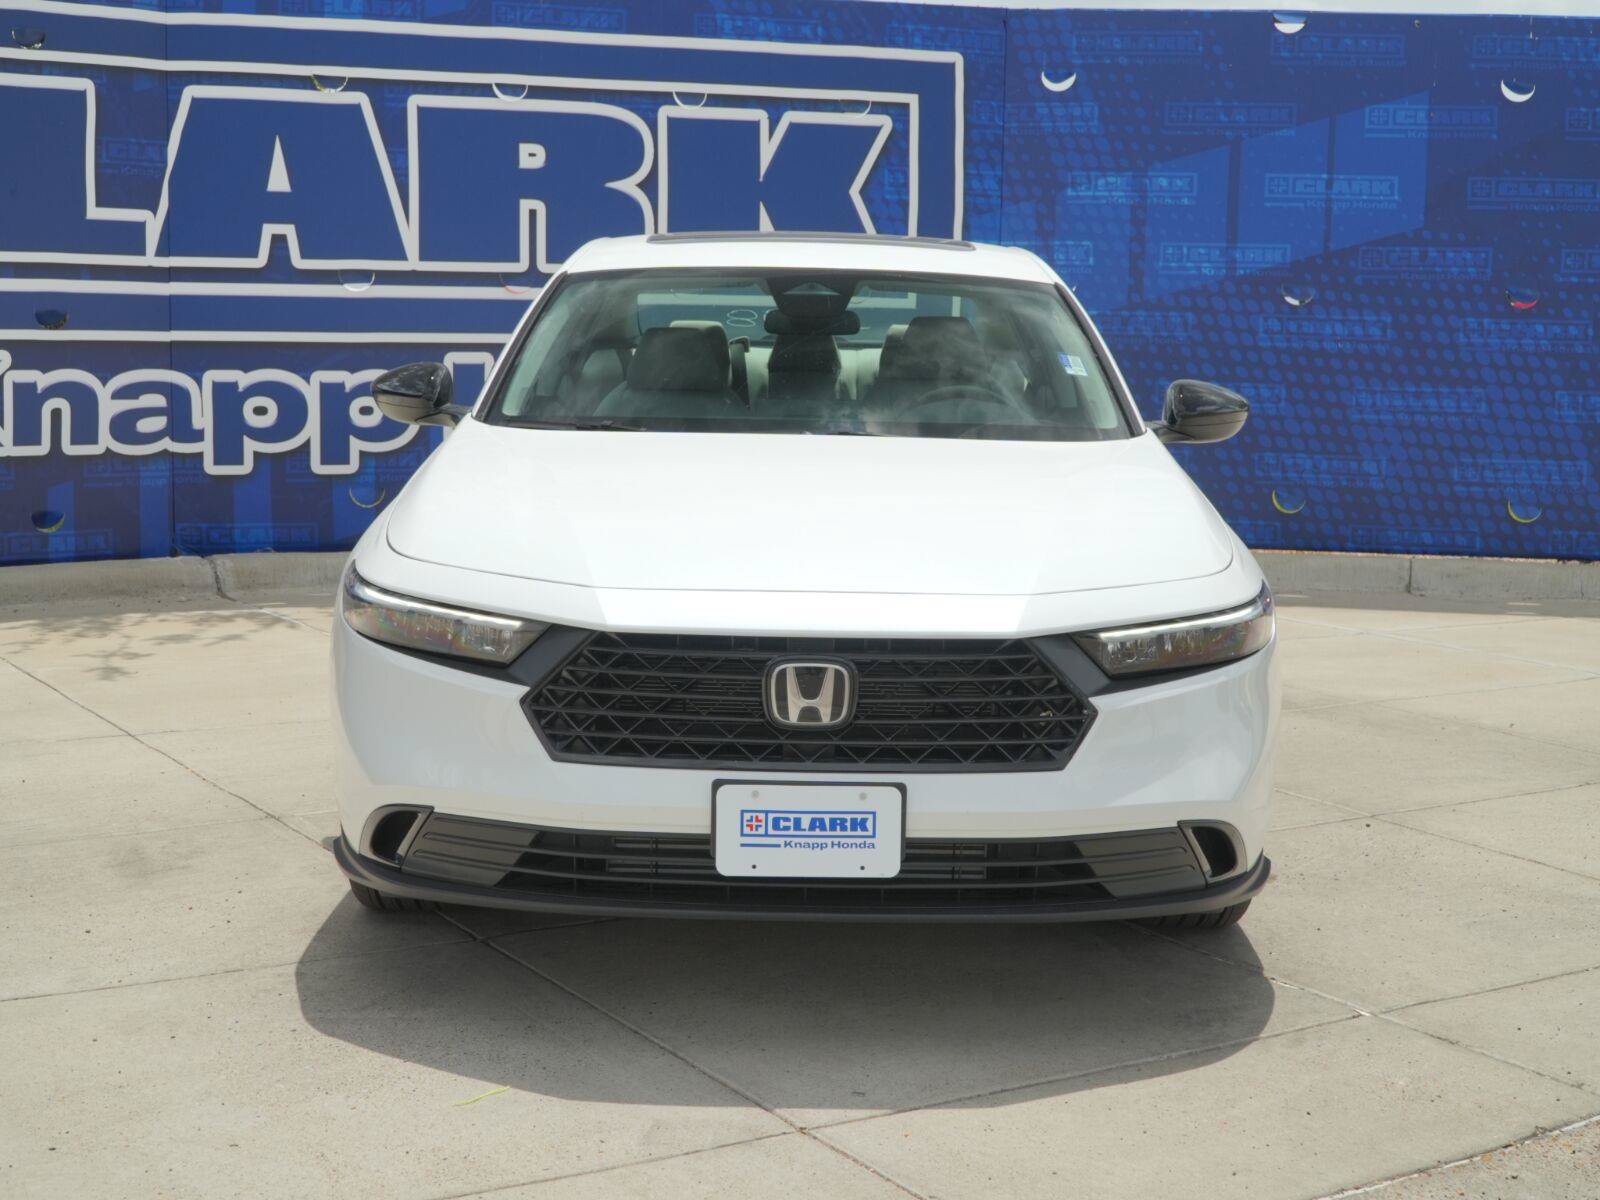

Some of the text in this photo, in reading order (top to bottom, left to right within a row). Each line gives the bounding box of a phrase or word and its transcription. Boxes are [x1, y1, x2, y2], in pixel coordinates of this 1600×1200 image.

[1295, 180, 1391, 195] CLARK
[0, 350, 420, 476] napp
[771, 816, 869, 832] CLARK
[783, 840, 876, 851] Knapp Honda
